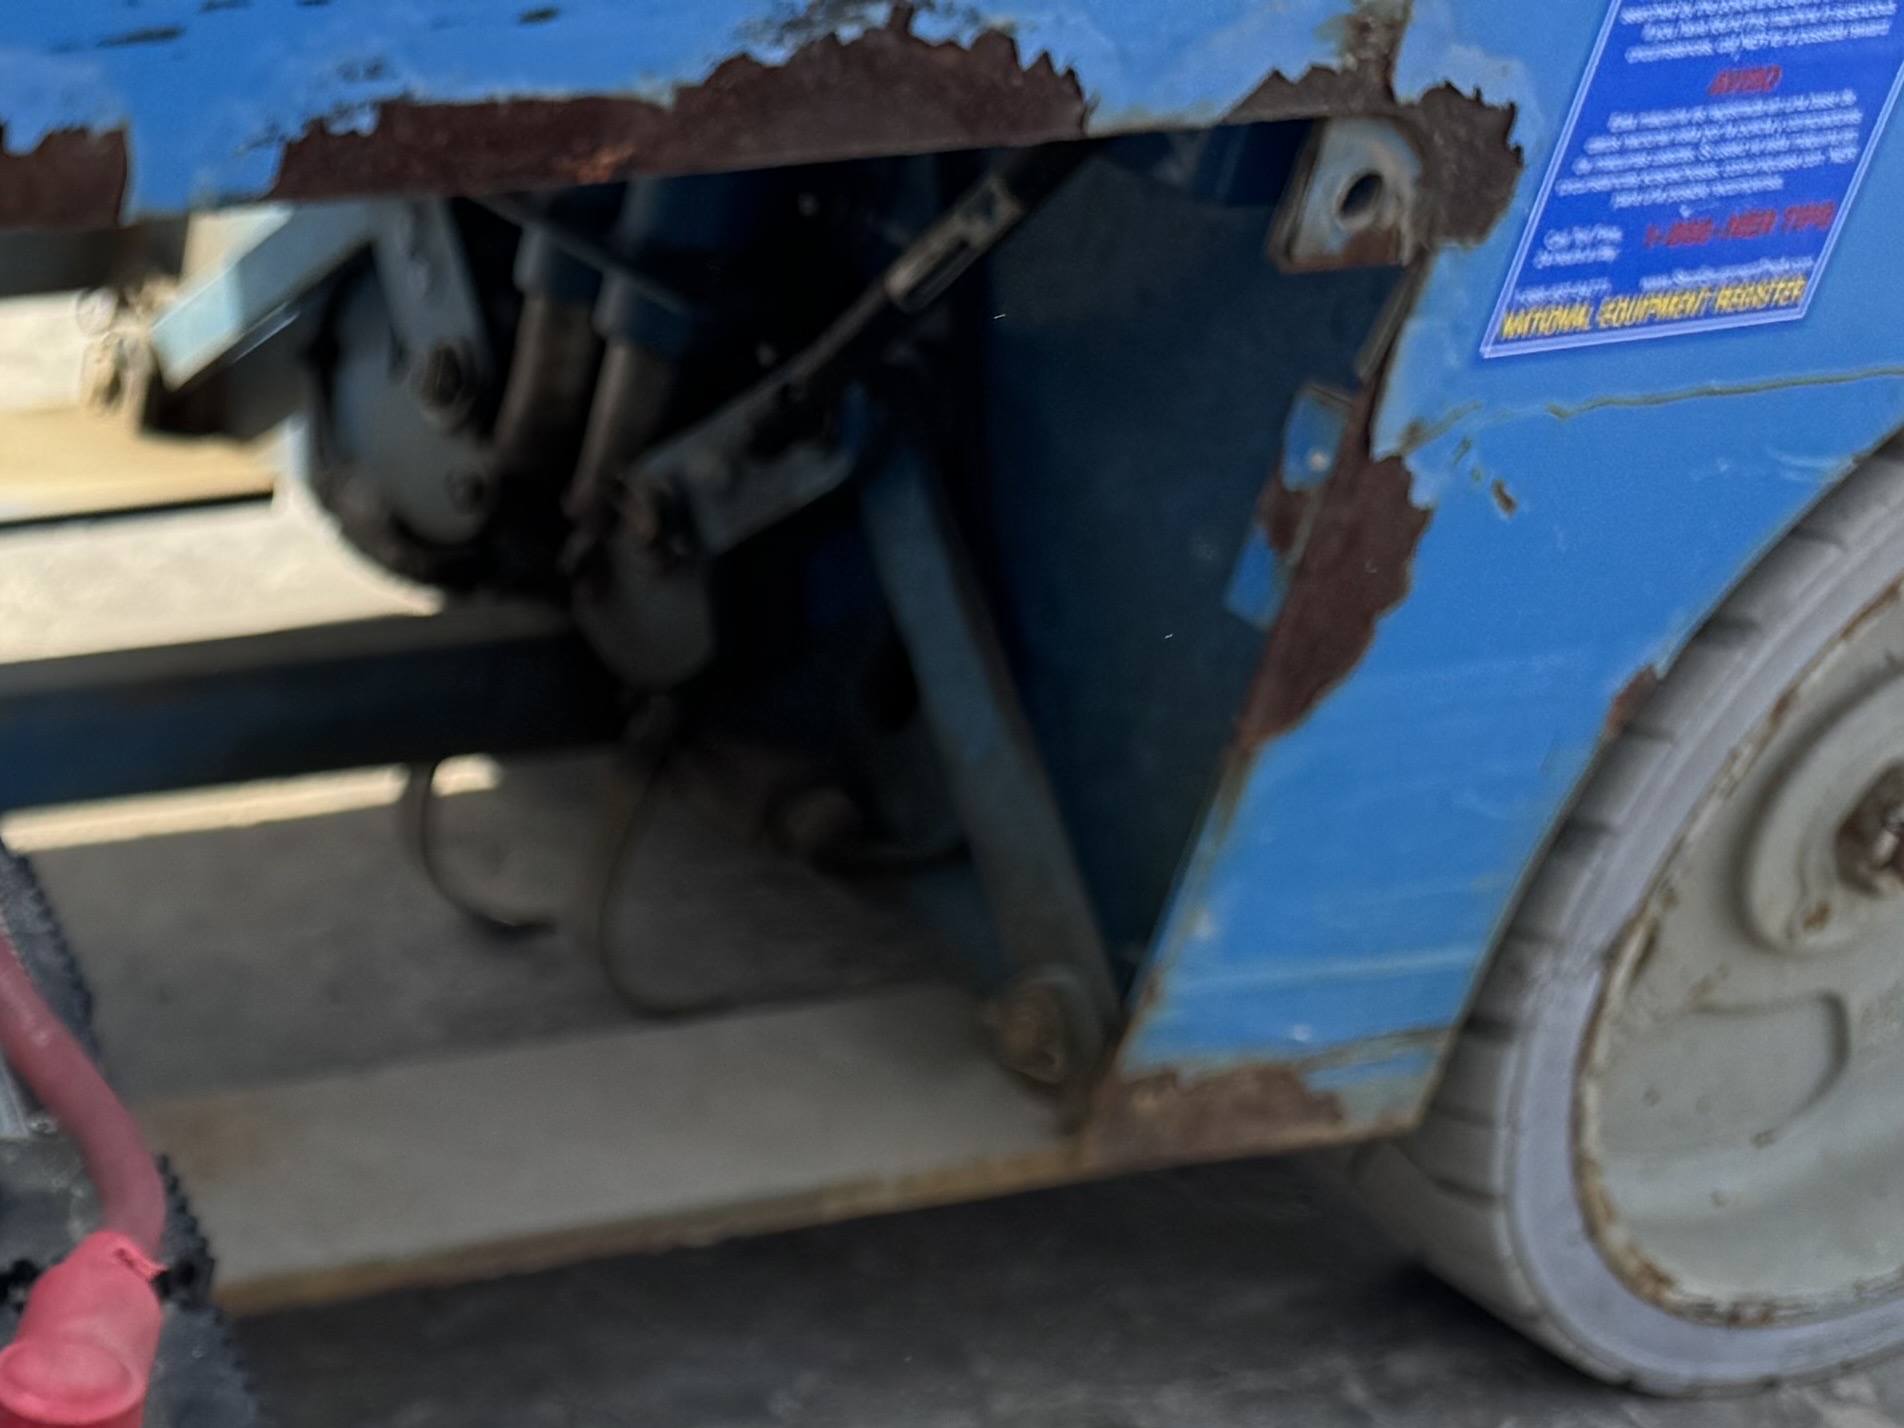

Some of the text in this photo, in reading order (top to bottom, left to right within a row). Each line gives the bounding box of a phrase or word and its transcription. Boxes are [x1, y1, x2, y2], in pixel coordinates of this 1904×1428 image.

[1500, 303, 1594, 340] NATIONAL
[1596, 287, 1712, 329] EQUIPMENT
[1714, 273, 1808, 313] REGISTER
